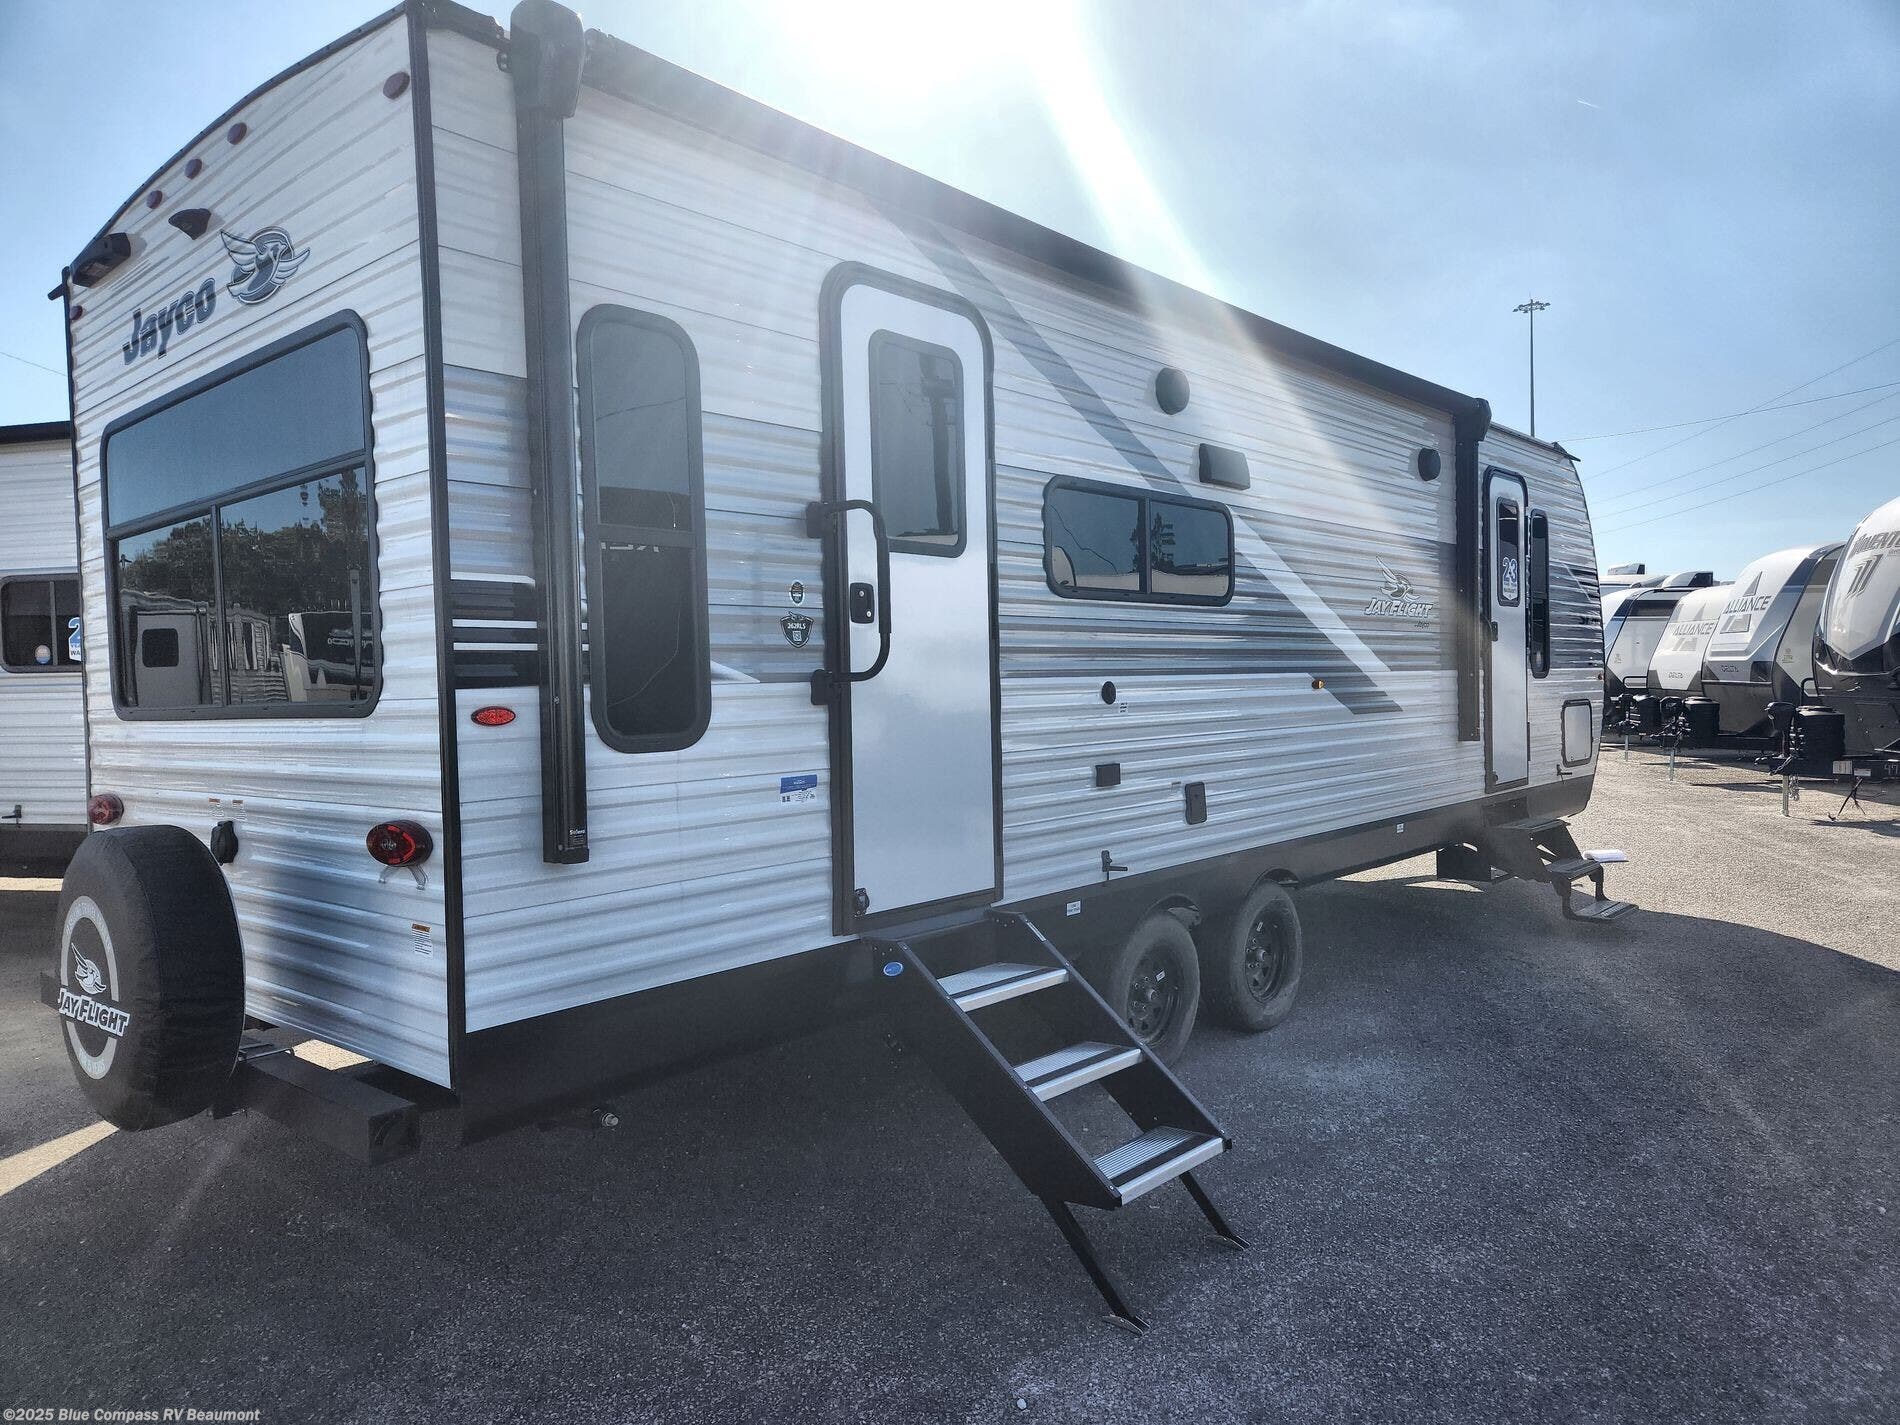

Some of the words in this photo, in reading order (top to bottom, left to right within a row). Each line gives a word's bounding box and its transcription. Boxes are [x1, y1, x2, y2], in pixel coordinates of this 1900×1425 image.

[122, 278, 216, 365] Jayco
[1722, 595, 1772, 614] ALLIANCE
[1672, 622, 1715, 636] ALLIANCE
